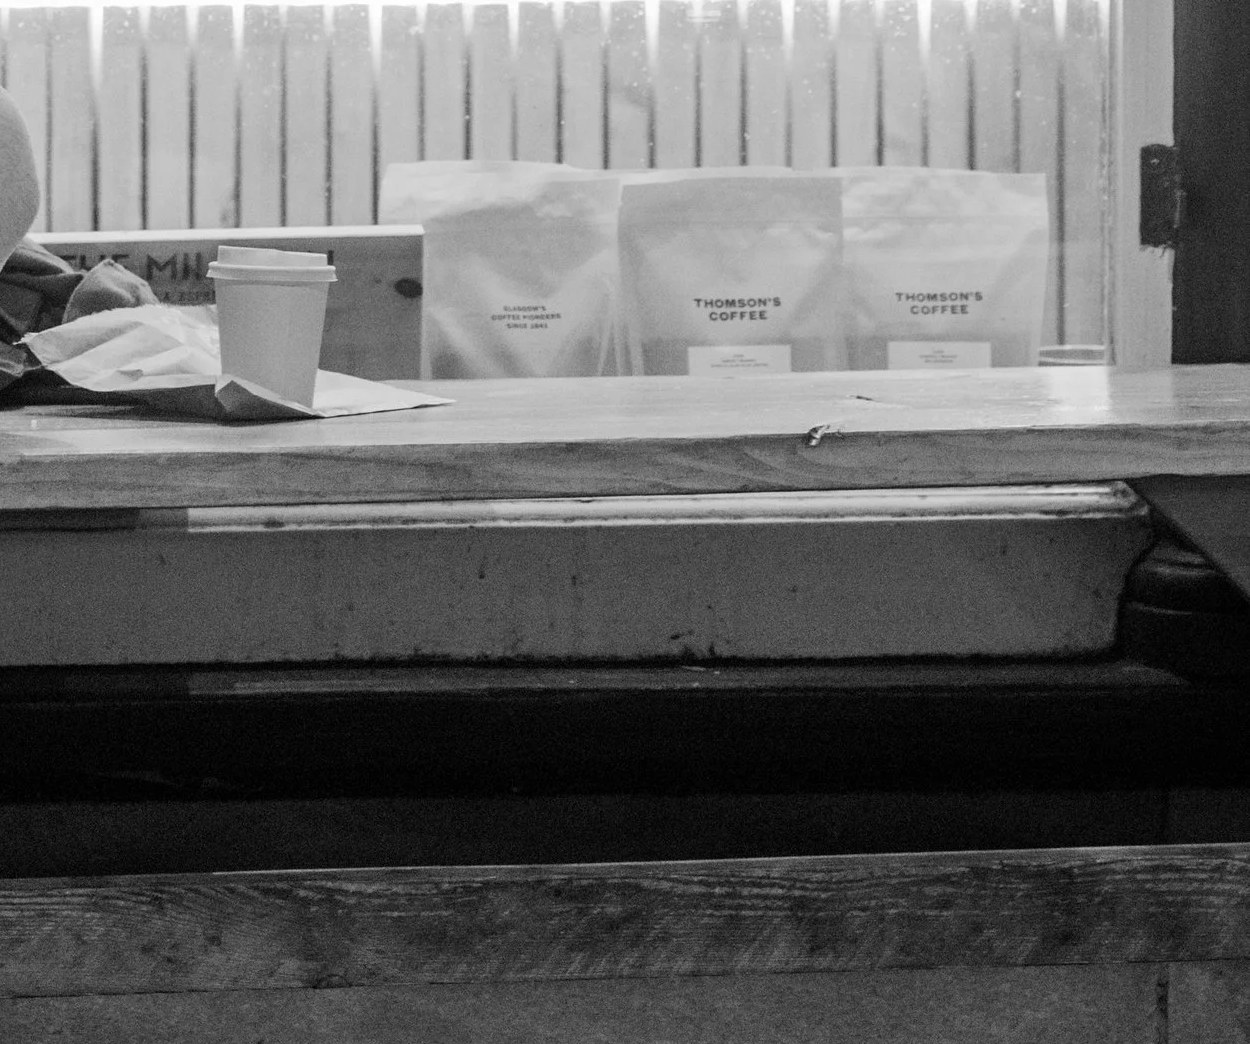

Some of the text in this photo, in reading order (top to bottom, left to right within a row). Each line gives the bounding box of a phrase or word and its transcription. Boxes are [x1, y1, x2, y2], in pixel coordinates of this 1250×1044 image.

[693, 296, 782, 308] THOMSON'S
[895, 291, 983, 302] THOMSON'S
[910, 304, 969, 315] COFFEE
[709, 310, 768, 321] COFFEE
